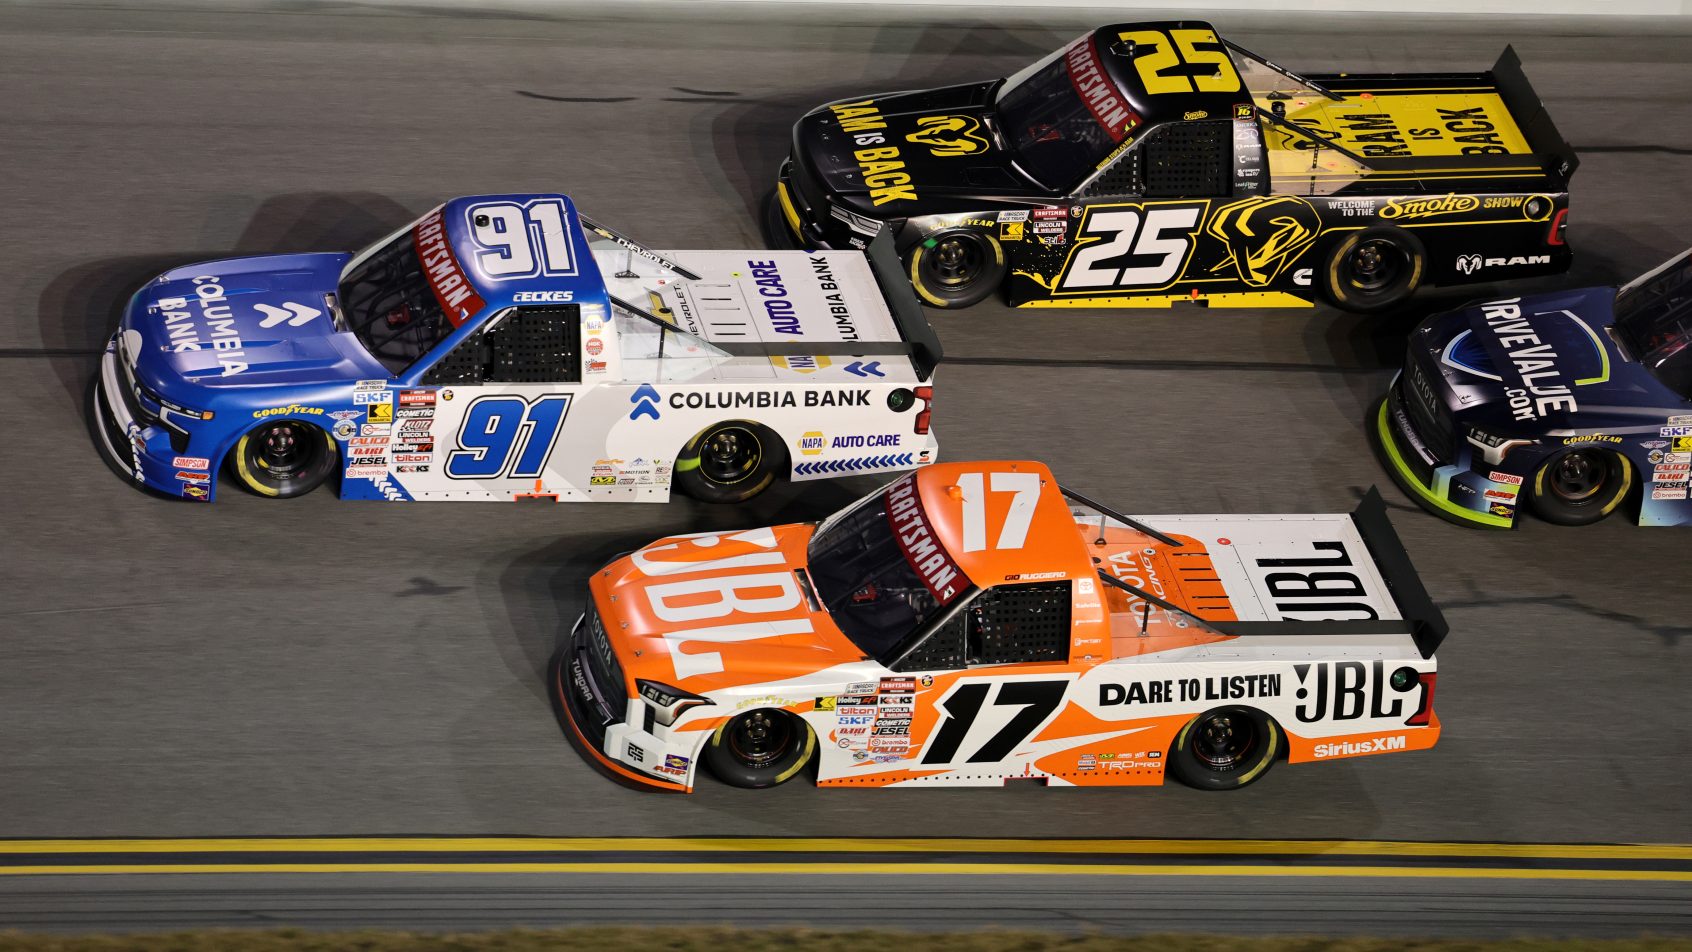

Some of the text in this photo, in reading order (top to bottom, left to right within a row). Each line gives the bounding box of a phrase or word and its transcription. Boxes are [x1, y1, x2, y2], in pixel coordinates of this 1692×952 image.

[1118, 29, 1241, 94] 25
[1069, 41, 1128, 128] RAFTSMAN
[853, 132, 885, 146] IS
[1335, 107, 1510, 156] RAM IS BACK
[854, 146, 918, 206] BACK
[1328, 200, 1375, 210] WELCOME
[1379, 192, 1524, 219] Smoke SHOW
[465, 198, 579, 282] 91
[616, 238, 676, 270] CHEVROLET
[1062, 208, 1200, 288] 25
[418, 211, 472, 308] RAFTSMAN
[809, 256, 839, 291] BANK
[1485, 256, 1550, 266] RAM
[748, 260, 804, 336] AUTO CARE
[158, 298, 202, 354] BANK
[192, 275, 248, 378] COLUMBIA
[356, 393, 391, 403] SKF
[669, 390, 872, 409] COLUMBIA BANK
[1414, 364, 1436, 414] TOYOTA
[253, 404, 324, 418] GOODYEAR
[404, 420, 430, 428] KLOTZ
[444, 393, 574, 480] 91
[802, 434, 900, 448] NAPA AUTO CARE
[1562, 432, 1622, 445] GOODYEAR
[1661, 427, 1691, 436] SKF
[175, 459, 206, 468] SIMPSON
[392, 444, 418, 452] Holley
[1491, 473, 1522, 484] SIMPSON
[955, 472, 1041, 553] 17
[593, 611, 612, 665] TOYOTA
[572, 658, 594, 702] TUNDRA
[1099, 674, 1282, 706] DARE TO LISTEN
[838, 696, 861, 704] Holley
[920, 680, 1070, 764] 17
[1314, 735, 1406, 758] SiriusXM
[654, 766, 686, 775] ARP
[1098, 760, 1134, 770] TRD
